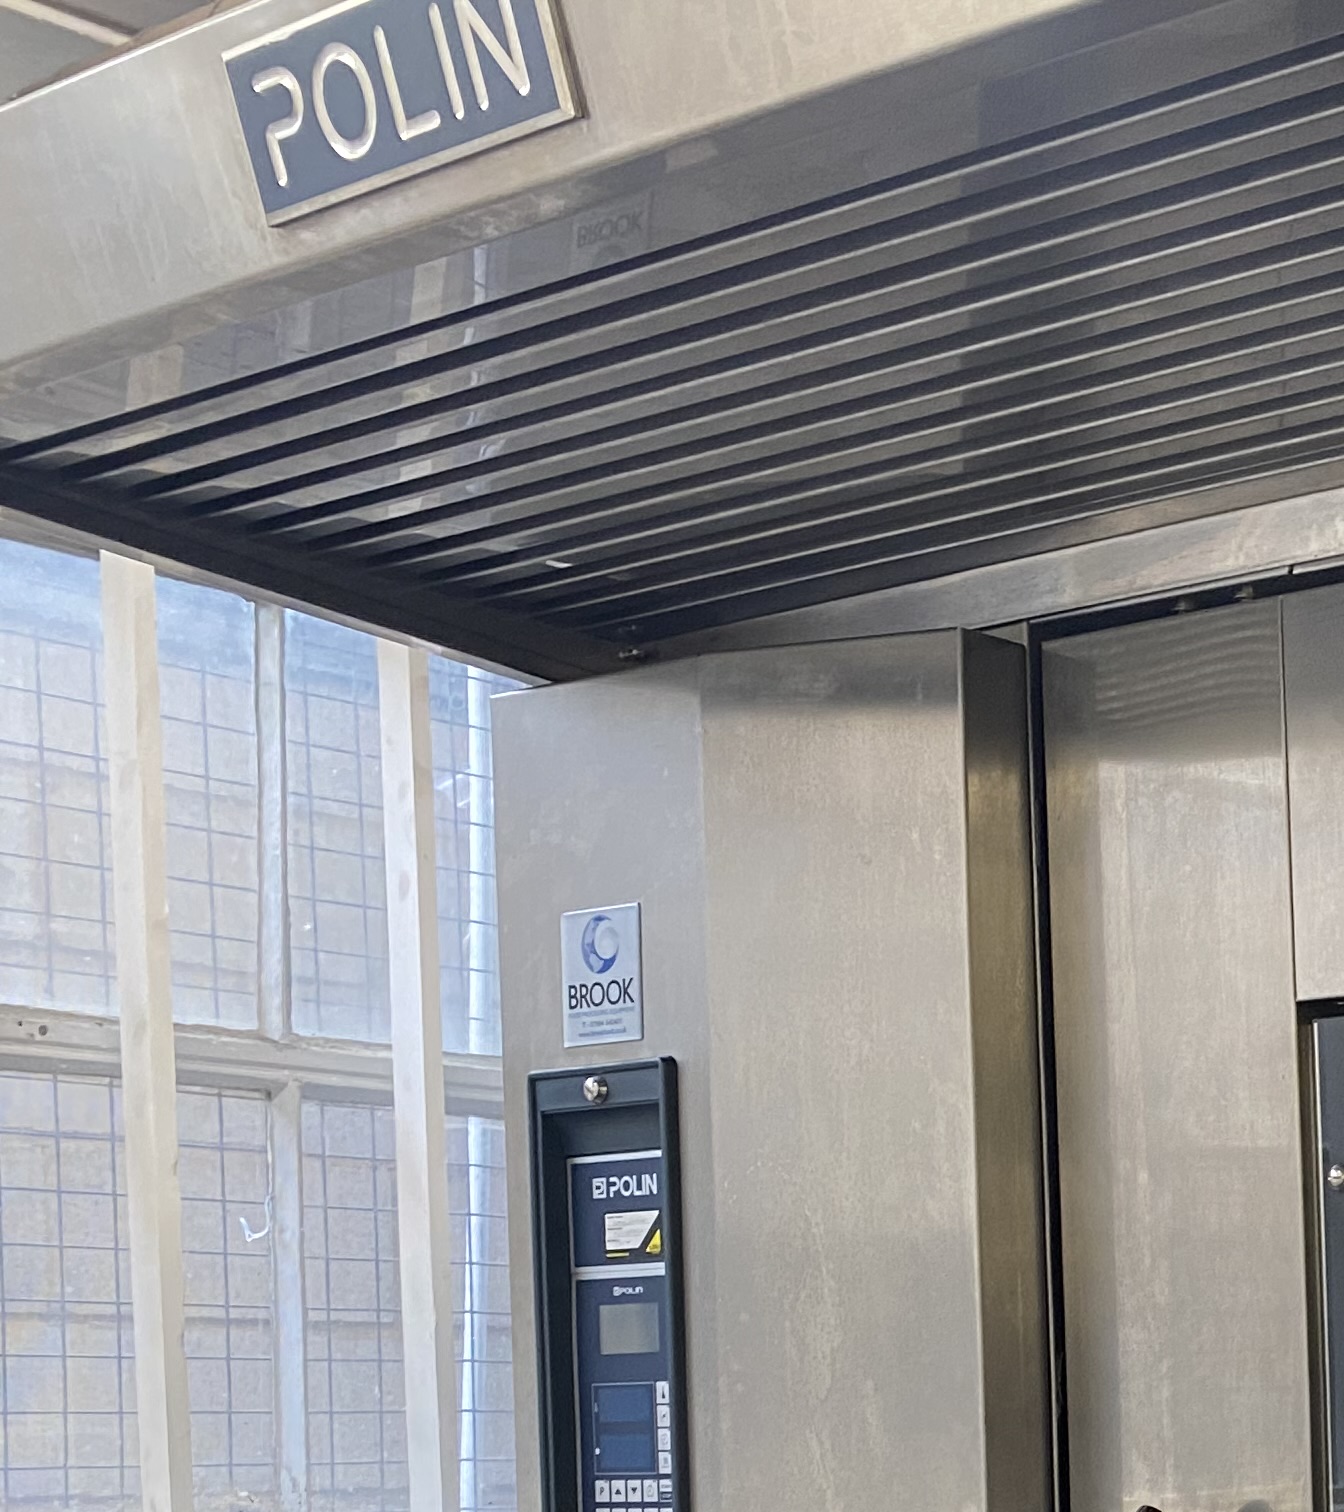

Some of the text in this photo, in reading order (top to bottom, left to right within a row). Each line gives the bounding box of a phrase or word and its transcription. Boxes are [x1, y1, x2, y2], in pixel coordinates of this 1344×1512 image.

[250, 0, 532, 188] POLIN
[568, 977, 635, 1010] BROOK
[609, 1173, 658, 1197] POLIN
